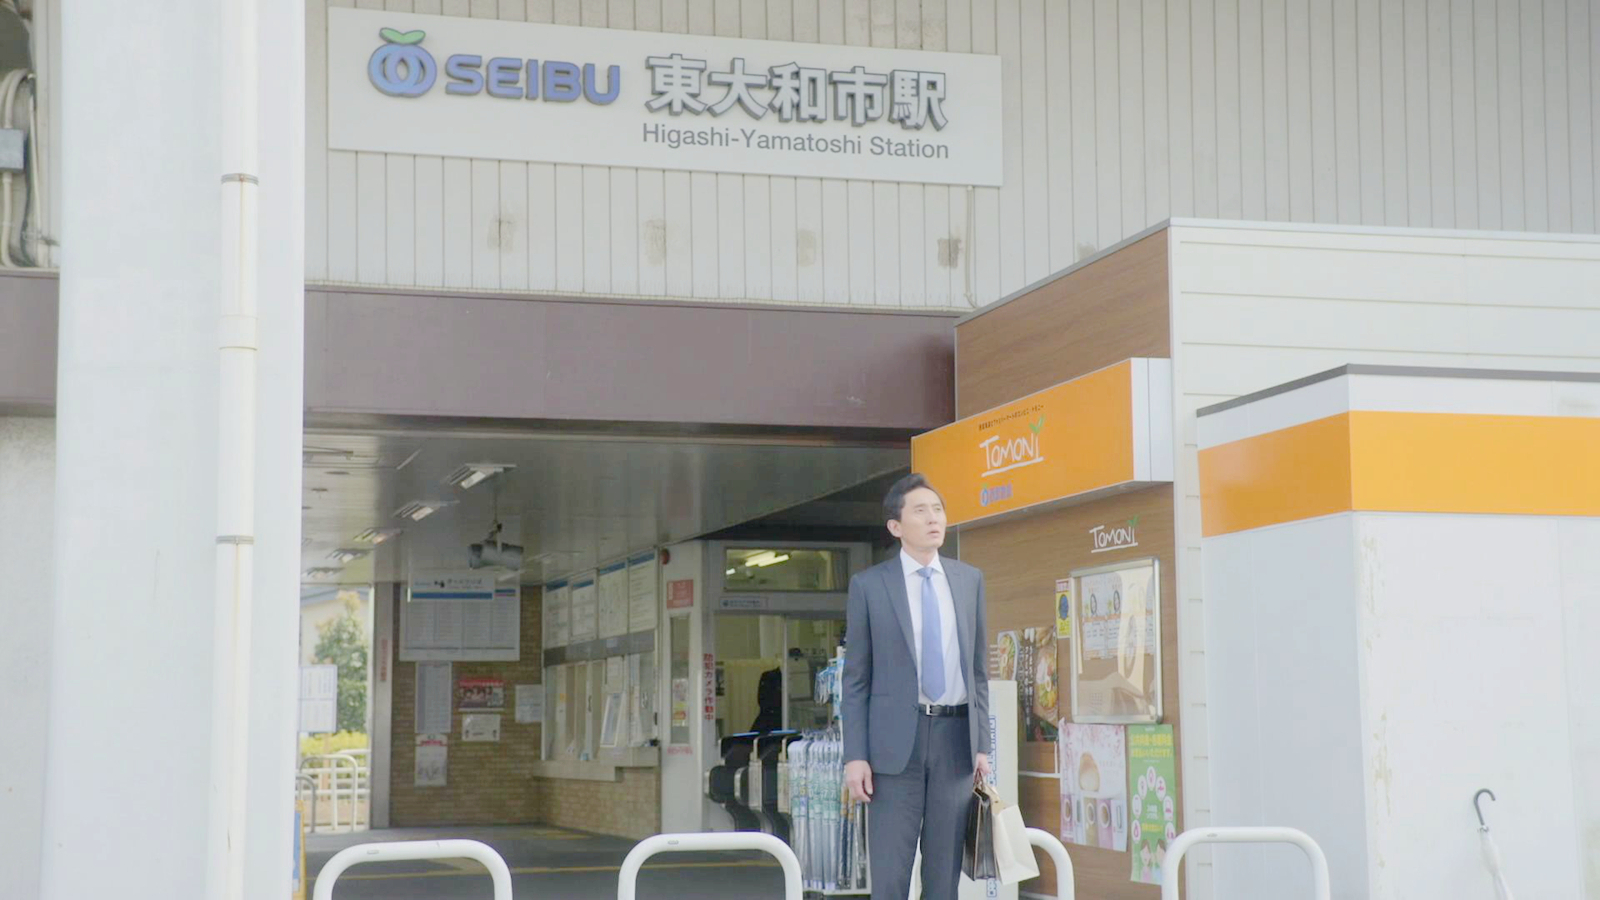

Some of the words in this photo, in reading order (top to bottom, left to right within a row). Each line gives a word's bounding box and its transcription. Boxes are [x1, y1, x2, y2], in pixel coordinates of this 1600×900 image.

[445, 54, 620, 105] SEIBU
[645, 53, 949, 131] 東大和市駅
[643, 122, 862, 156] Higashi-Yamatoshi
[869, 136, 950, 159] Station
